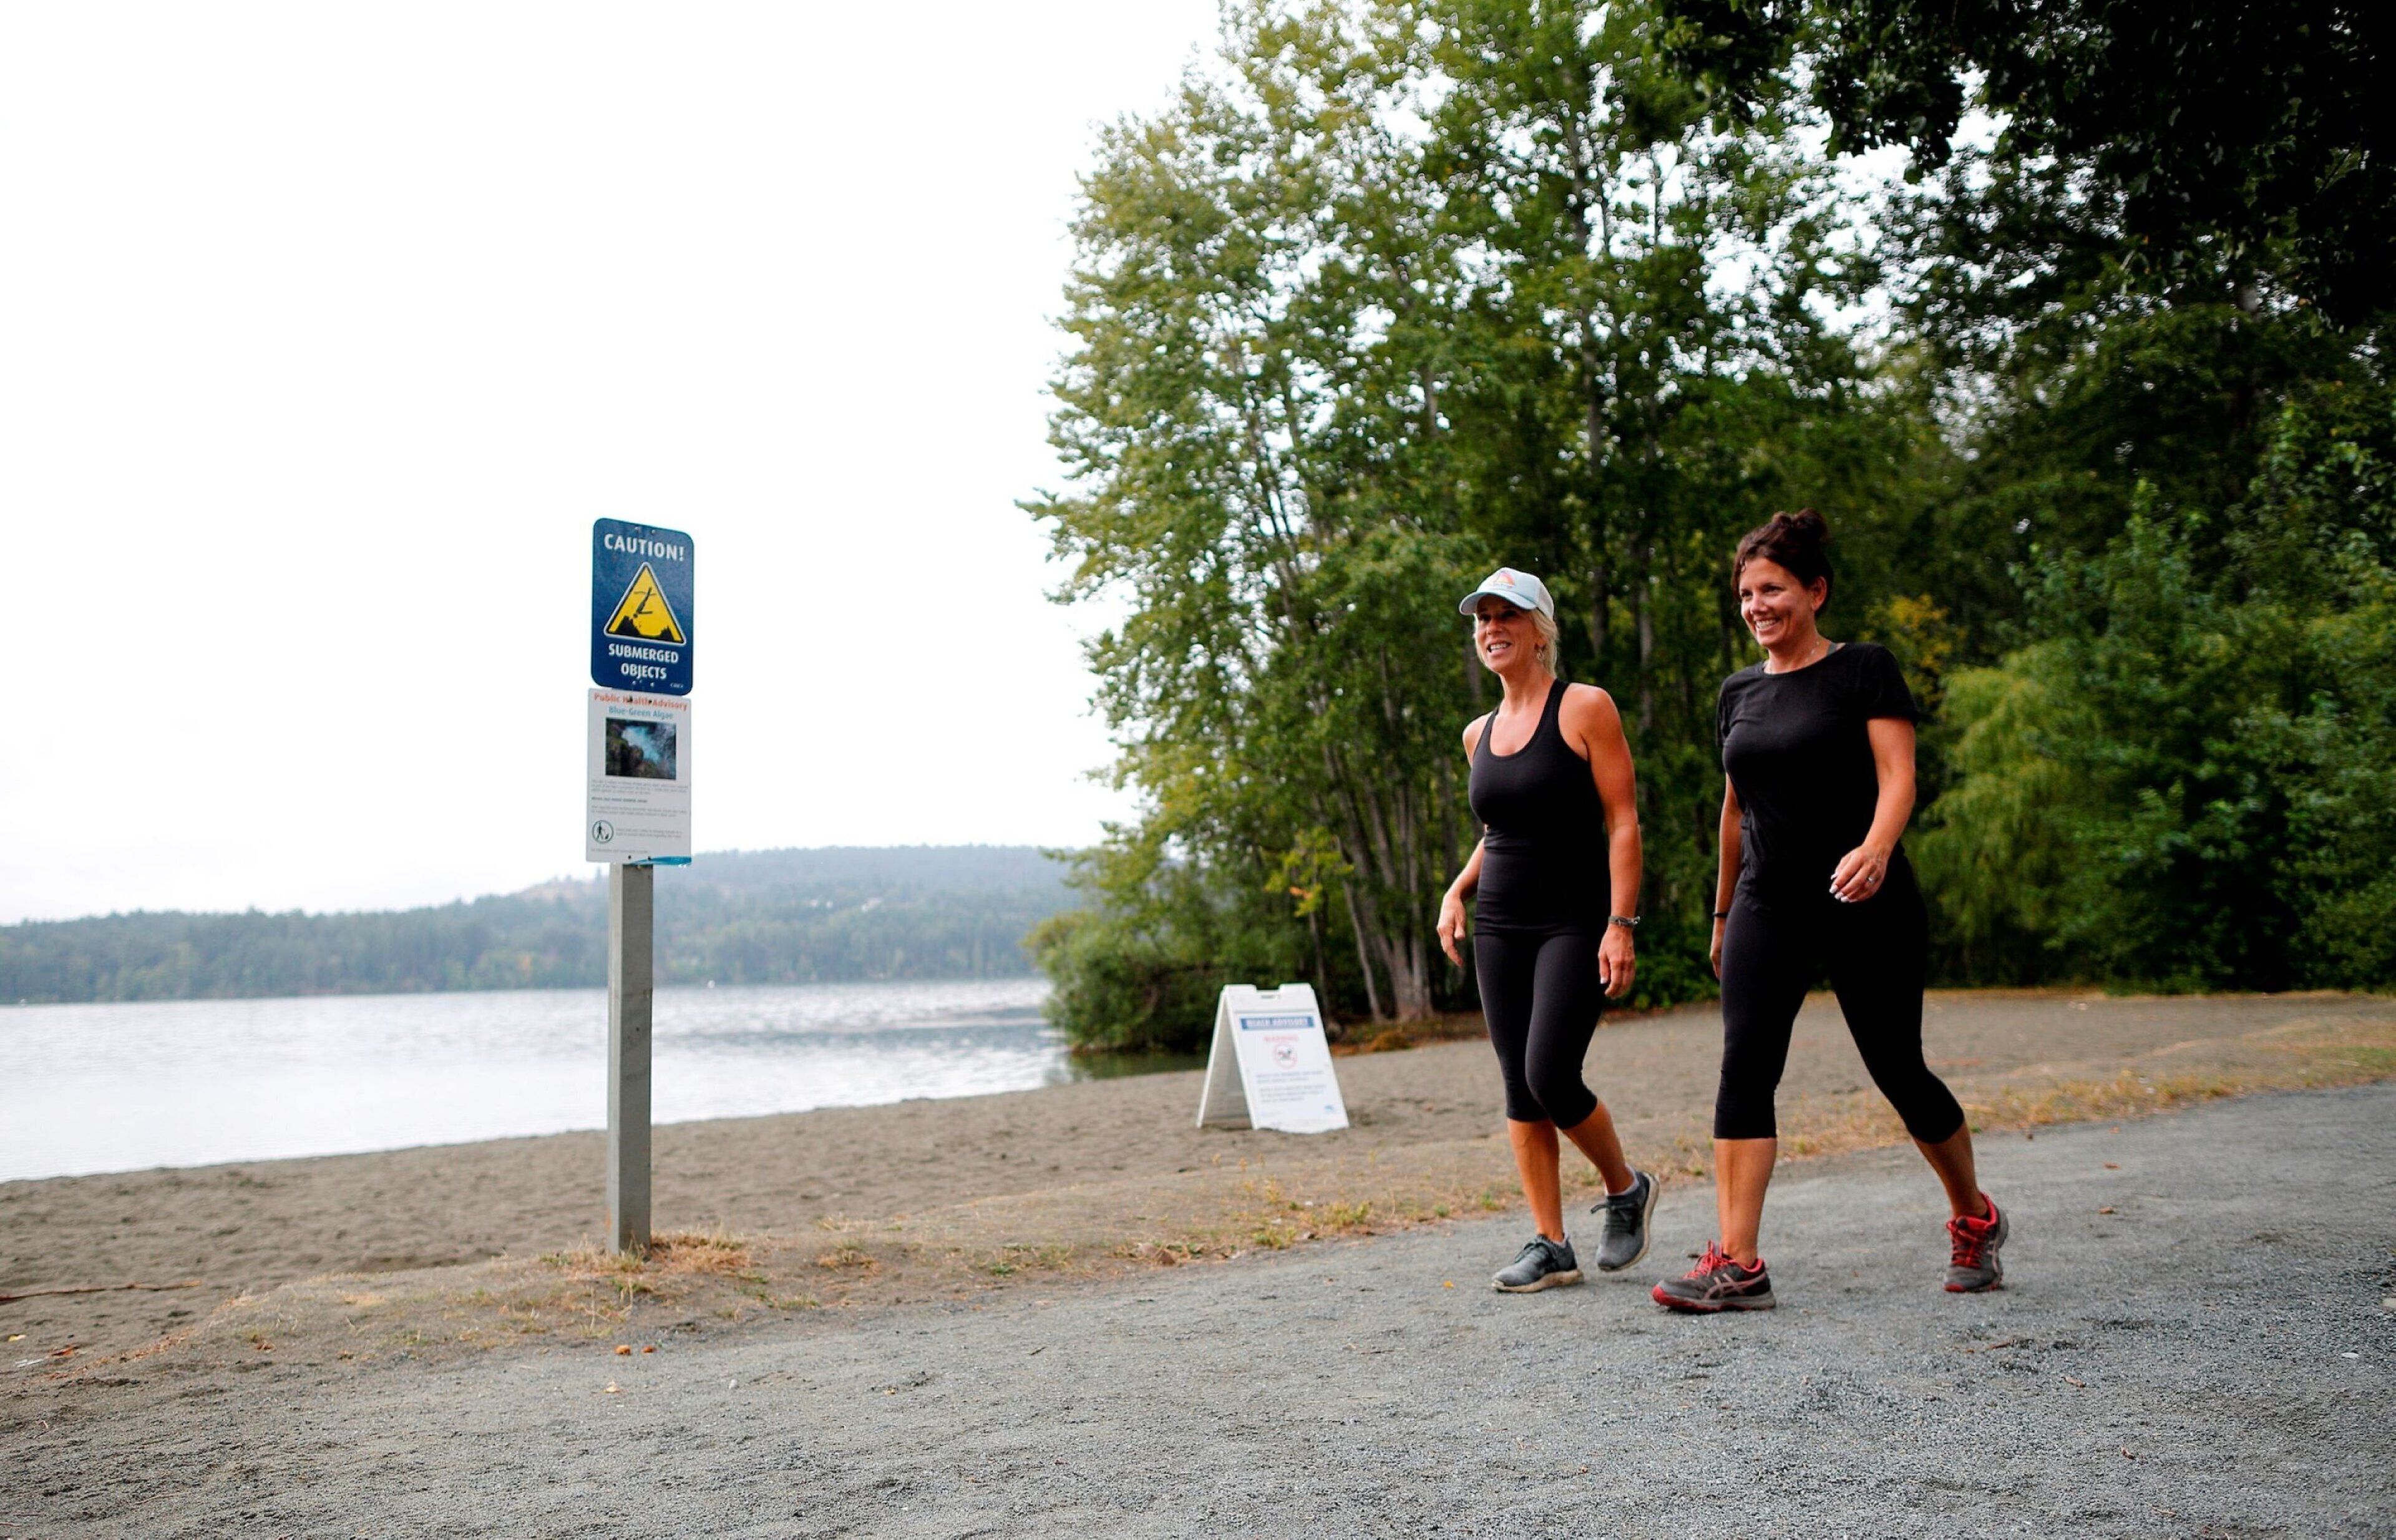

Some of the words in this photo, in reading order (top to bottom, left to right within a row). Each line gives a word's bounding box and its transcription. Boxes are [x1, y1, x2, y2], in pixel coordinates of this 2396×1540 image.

[603, 533, 684, 562] CAUTION!
[608, 643, 679, 663] SUBMERGED
[621, 663, 667, 680] OBJECTS
[594, 693, 619, 703] Public
[623, 696, 651, 706] Halth
[653, 699, 688, 711] Advisory
